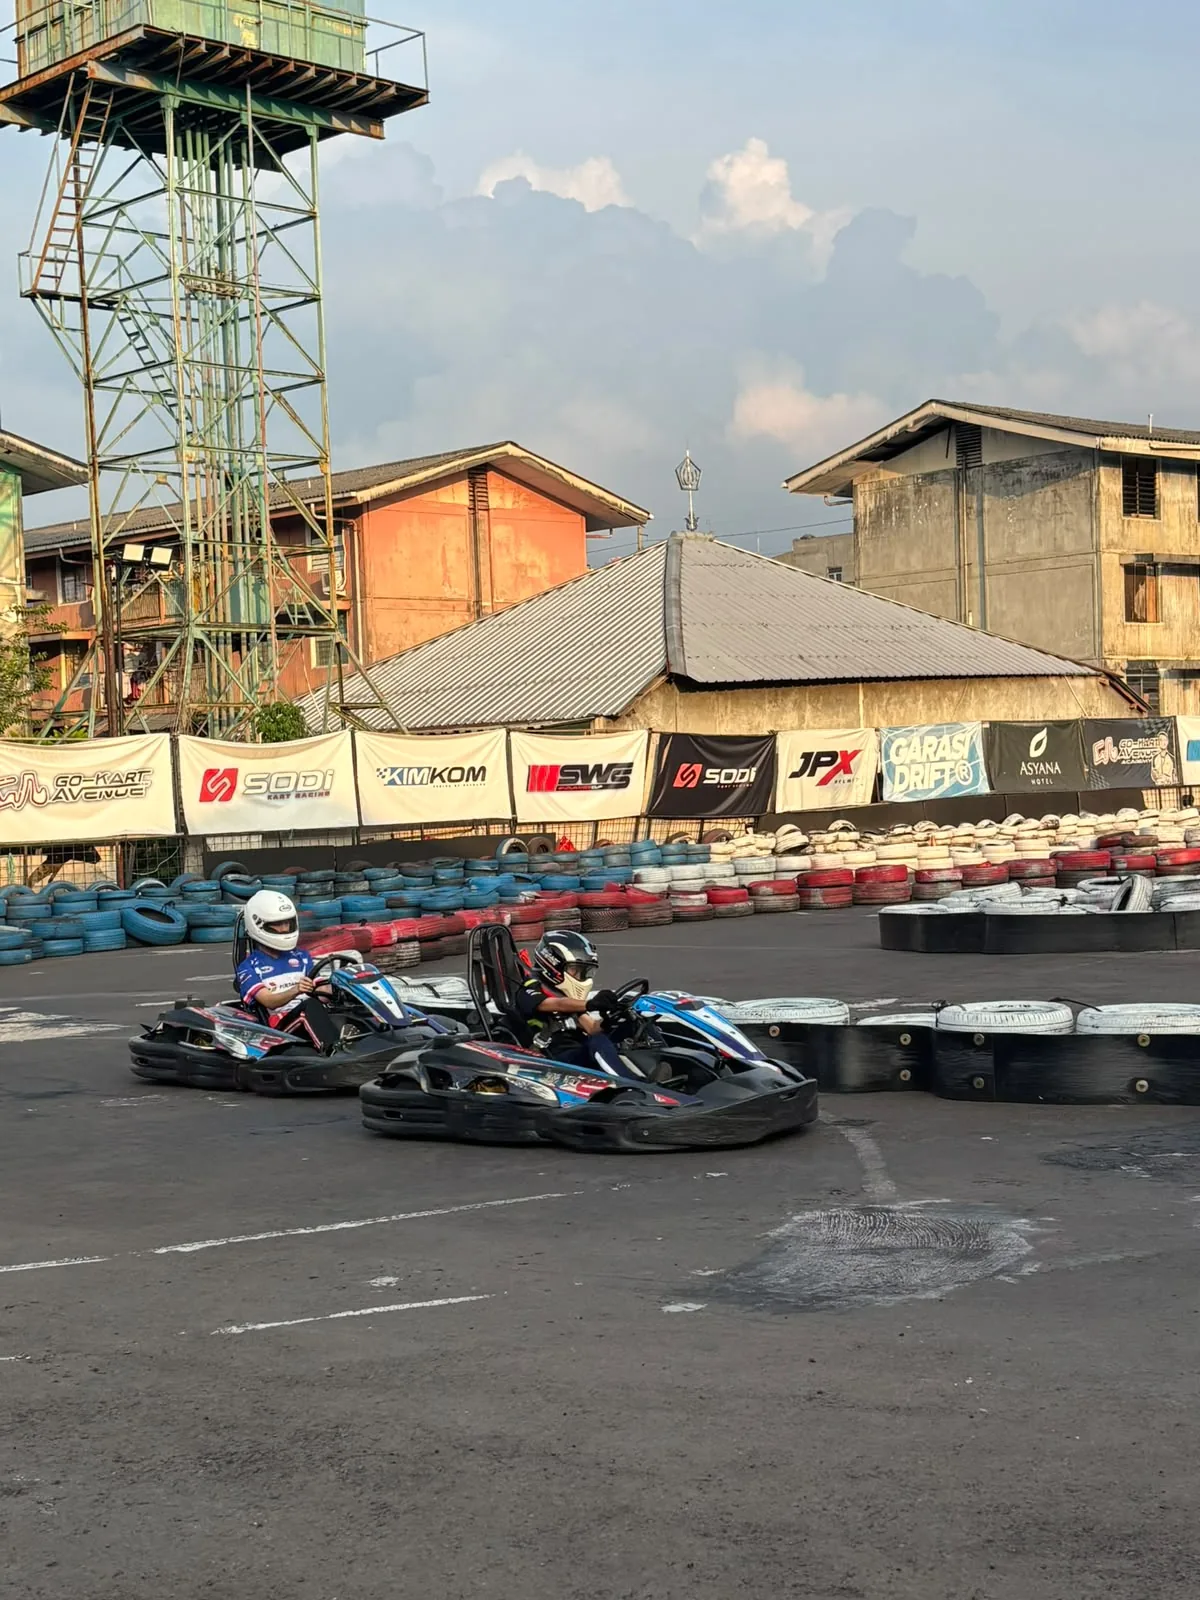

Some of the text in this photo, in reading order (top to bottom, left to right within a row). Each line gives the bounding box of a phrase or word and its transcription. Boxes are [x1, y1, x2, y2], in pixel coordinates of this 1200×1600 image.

[890, 733, 971, 765] GARASI
[55, 770, 151, 787] GO-KART
[788, 749, 863, 787] JPX
[1020, 761, 1062, 775] ASYANA
